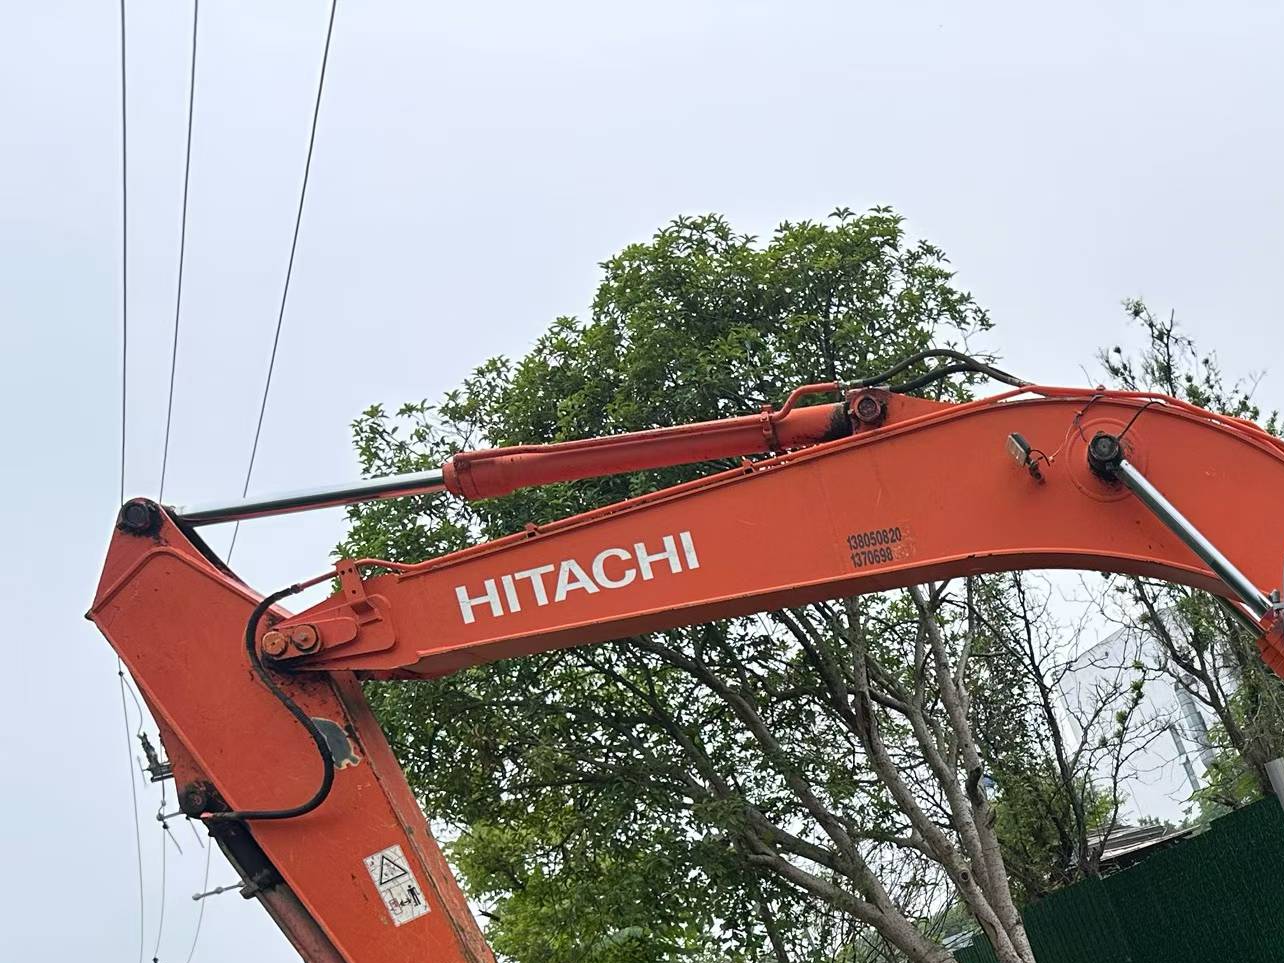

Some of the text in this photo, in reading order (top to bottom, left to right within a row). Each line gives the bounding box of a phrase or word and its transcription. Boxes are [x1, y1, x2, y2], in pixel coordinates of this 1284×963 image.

[847, 527, 902, 550] 138050820
[851, 546, 893, 568] 1370698
[455, 531, 700, 624] HITACHI
